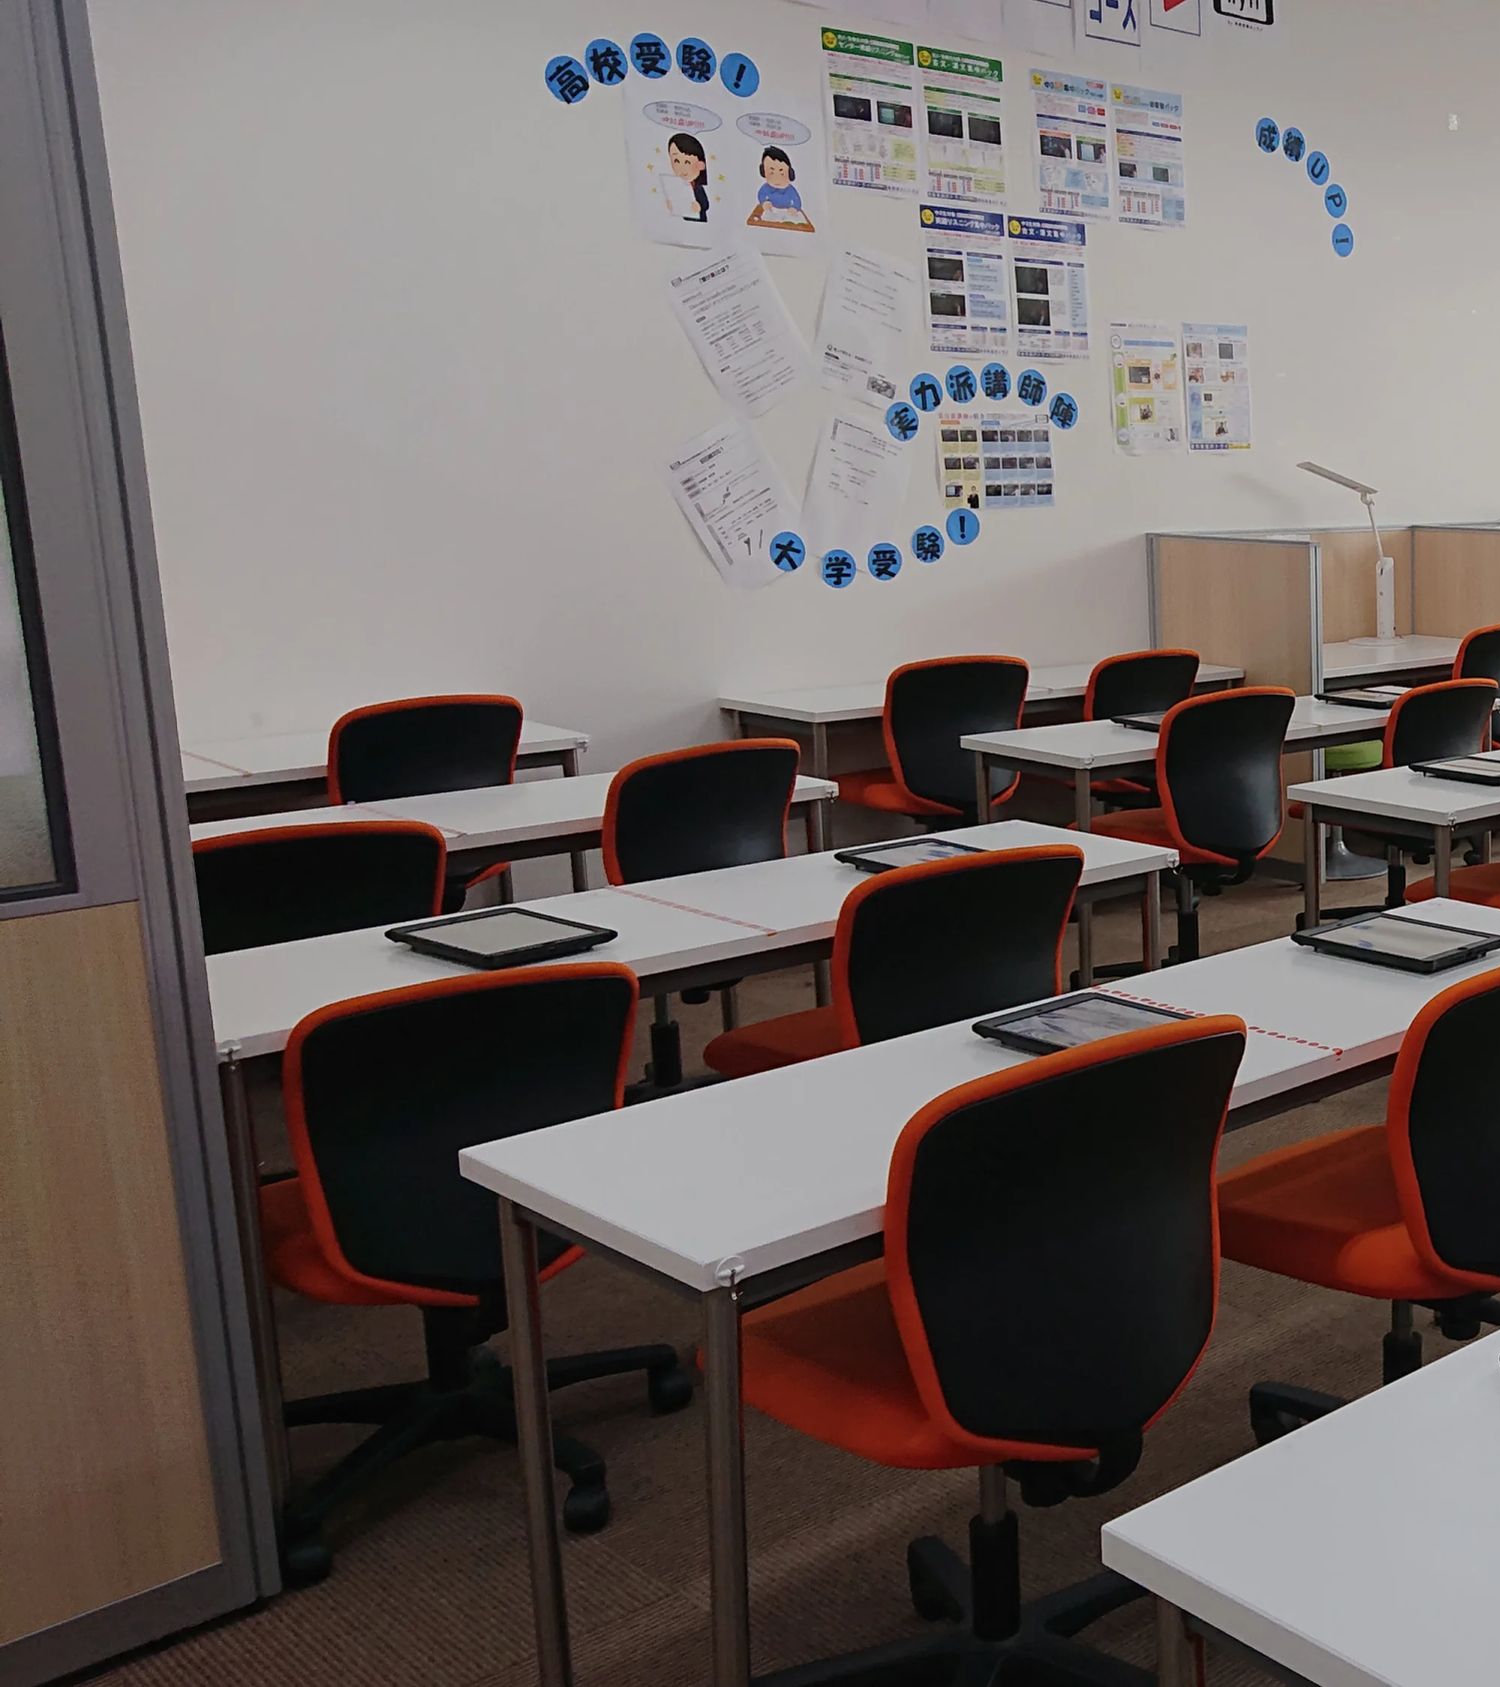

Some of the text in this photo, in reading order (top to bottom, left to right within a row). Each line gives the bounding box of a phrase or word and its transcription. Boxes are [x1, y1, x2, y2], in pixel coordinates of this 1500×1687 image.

[547, 40, 748, 105] 高校受験!
[892, 371, 1077, 440] 実力派講師陣
[773, 515, 966, 585] 大学受験!
